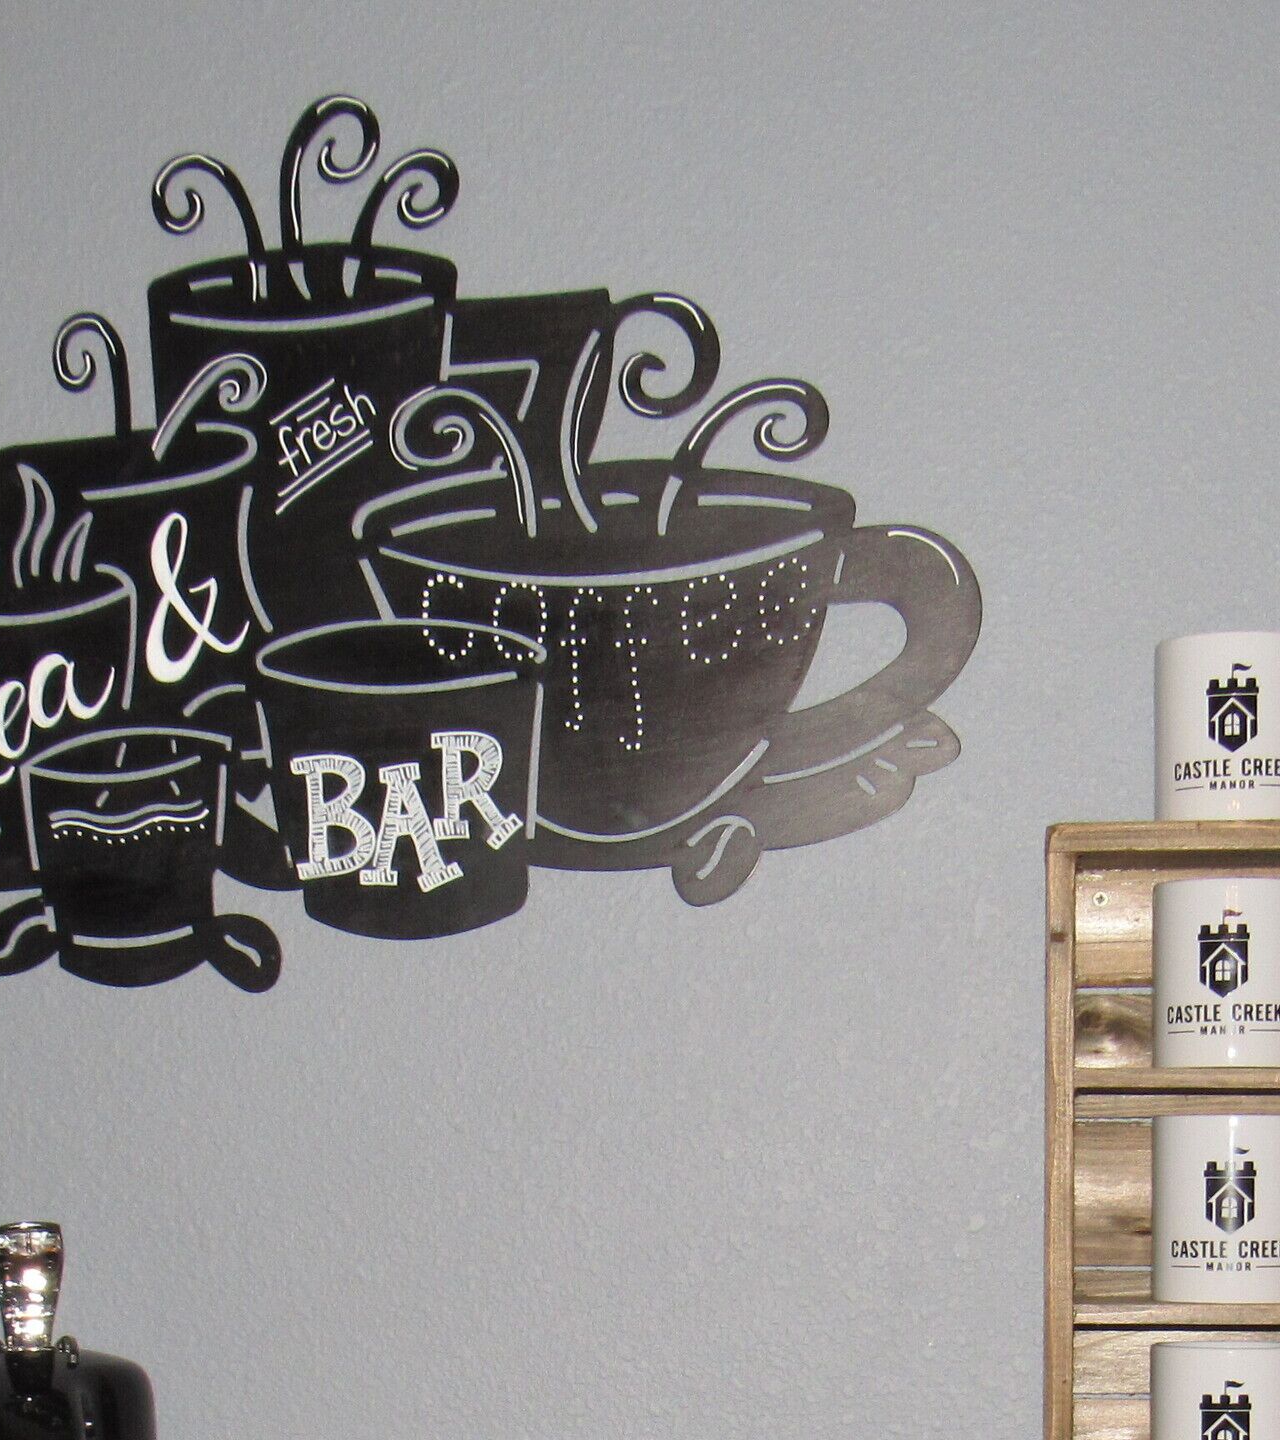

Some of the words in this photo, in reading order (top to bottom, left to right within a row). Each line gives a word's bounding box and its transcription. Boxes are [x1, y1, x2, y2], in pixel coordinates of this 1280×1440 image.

[278, 384, 377, 478] fresh
[146, 512, 251, 683] &
[422, 556, 818, 752] coffee
[1174, 758, 1231, 781] CASTLE
[1209, 780, 1255, 790] MANOR
[289, 730, 524, 893] BAR
[1167, 1004, 1221, 1024] CASTLE
[1171, 1240, 1227, 1259] CASTLE
[1205, 1262, 1252, 1272] MANOR
